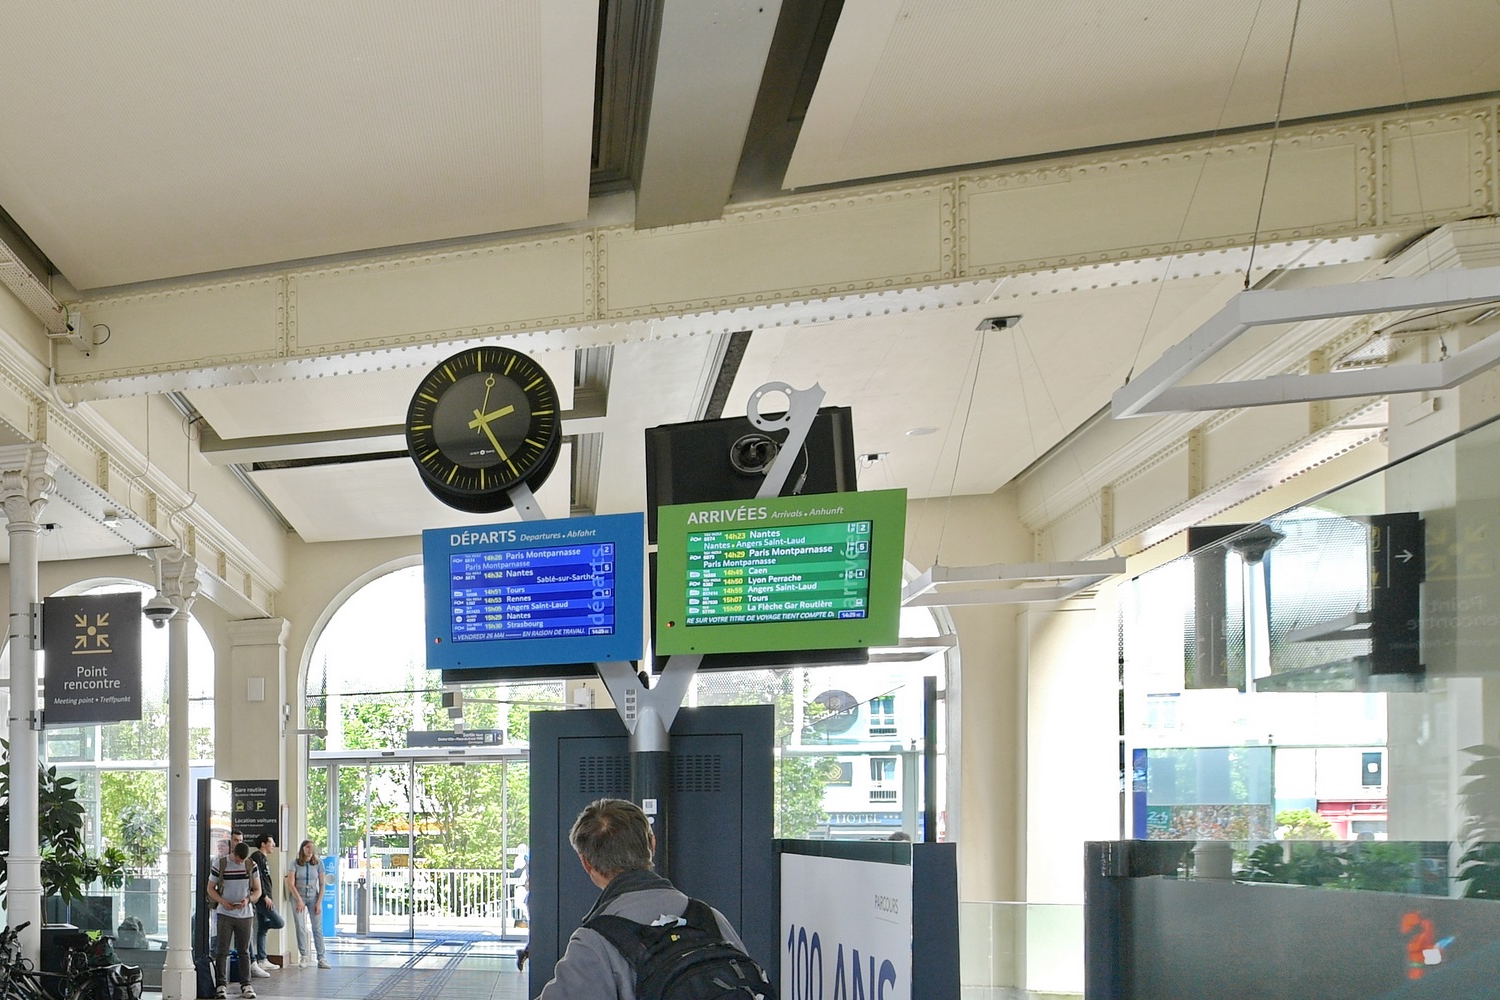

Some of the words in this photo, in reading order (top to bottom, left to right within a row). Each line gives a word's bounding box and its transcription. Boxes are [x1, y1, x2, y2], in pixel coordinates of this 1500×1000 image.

[687, 506, 767, 524] ARRIVÉES
[771, 510, 802, 518] Arrivals
[450, 530, 517, 546] DÉPARTS
[520, 532, 561, 542] Departures
[567, 529, 596, 538] Abfahrt
[750, 530, 780, 538] Nantes
[764, 537, 806, 546] Saint-Laud
[526, 549, 580, 559] Montparnasse
[749, 548, 770, 557] Paris
[772, 545, 833, 556] Montparnasse
[482, 560, 530, 570] Montparnasse
[722, 558, 776, 568] Montparnasse
[506, 570, 533, 578] Nantes
[748, 576, 766, 585] Lyon
[768, 575, 802, 583] Perrache
[748, 586, 774, 594] Angers
[775, 582, 817, 591] Saint-Laud
[506, 604, 529, 612] Angers
[531, 601, 568, 610] Saint-Laud
[758, 602, 784, 610] Flèche
[76, 666, 108, 678] Point
[64, 678, 120, 690] rencontre
[100, 696, 131, 704] Treffpunkt
[257, 802, 263, 810] P
[836, 814, 882, 824] HOTEL
[874, 894, 899, 915] PARCOURS
